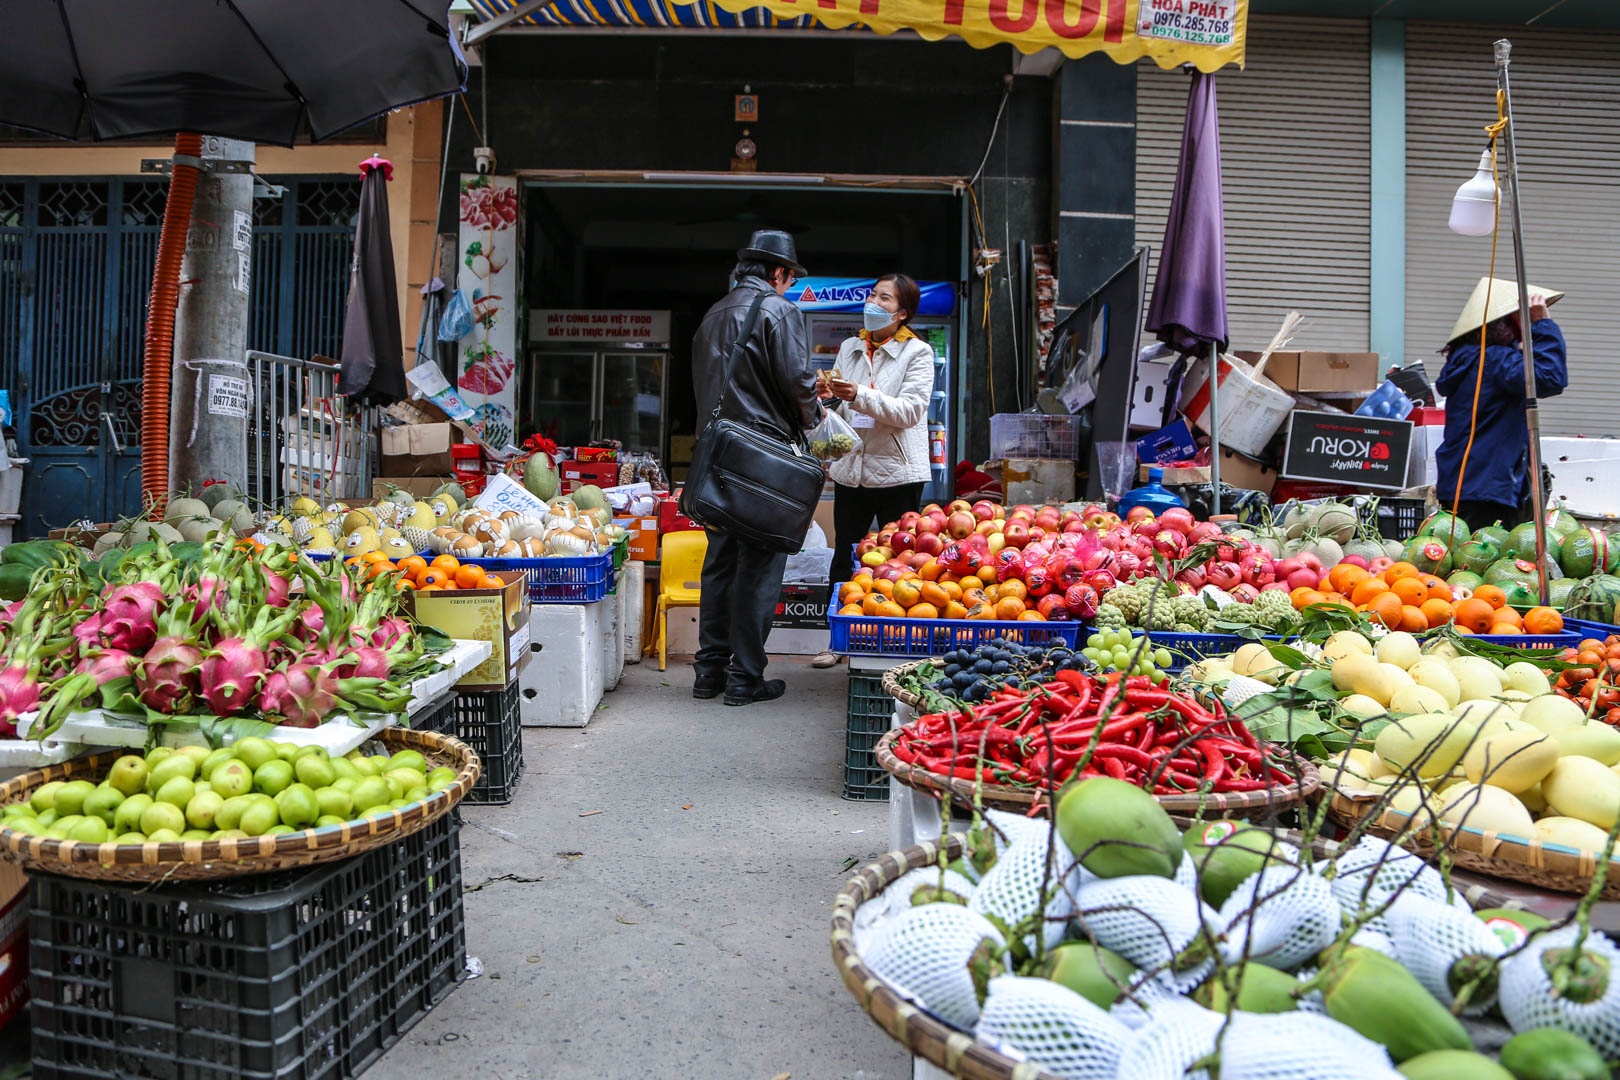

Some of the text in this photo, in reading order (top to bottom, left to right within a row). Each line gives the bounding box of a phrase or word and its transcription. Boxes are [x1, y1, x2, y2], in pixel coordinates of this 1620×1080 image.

[1188, 0, 1228, 19] PHÁT
[1154, 12, 1230, 33] 0976.285.768
[1151, 26, 1231, 44] 0976.125.768
[591, 315, 608, 324] SAO
[630, 315, 653, 325] FOOD
[1310, 436, 1371, 458] KORU
[785, 603, 825, 616] KORU
